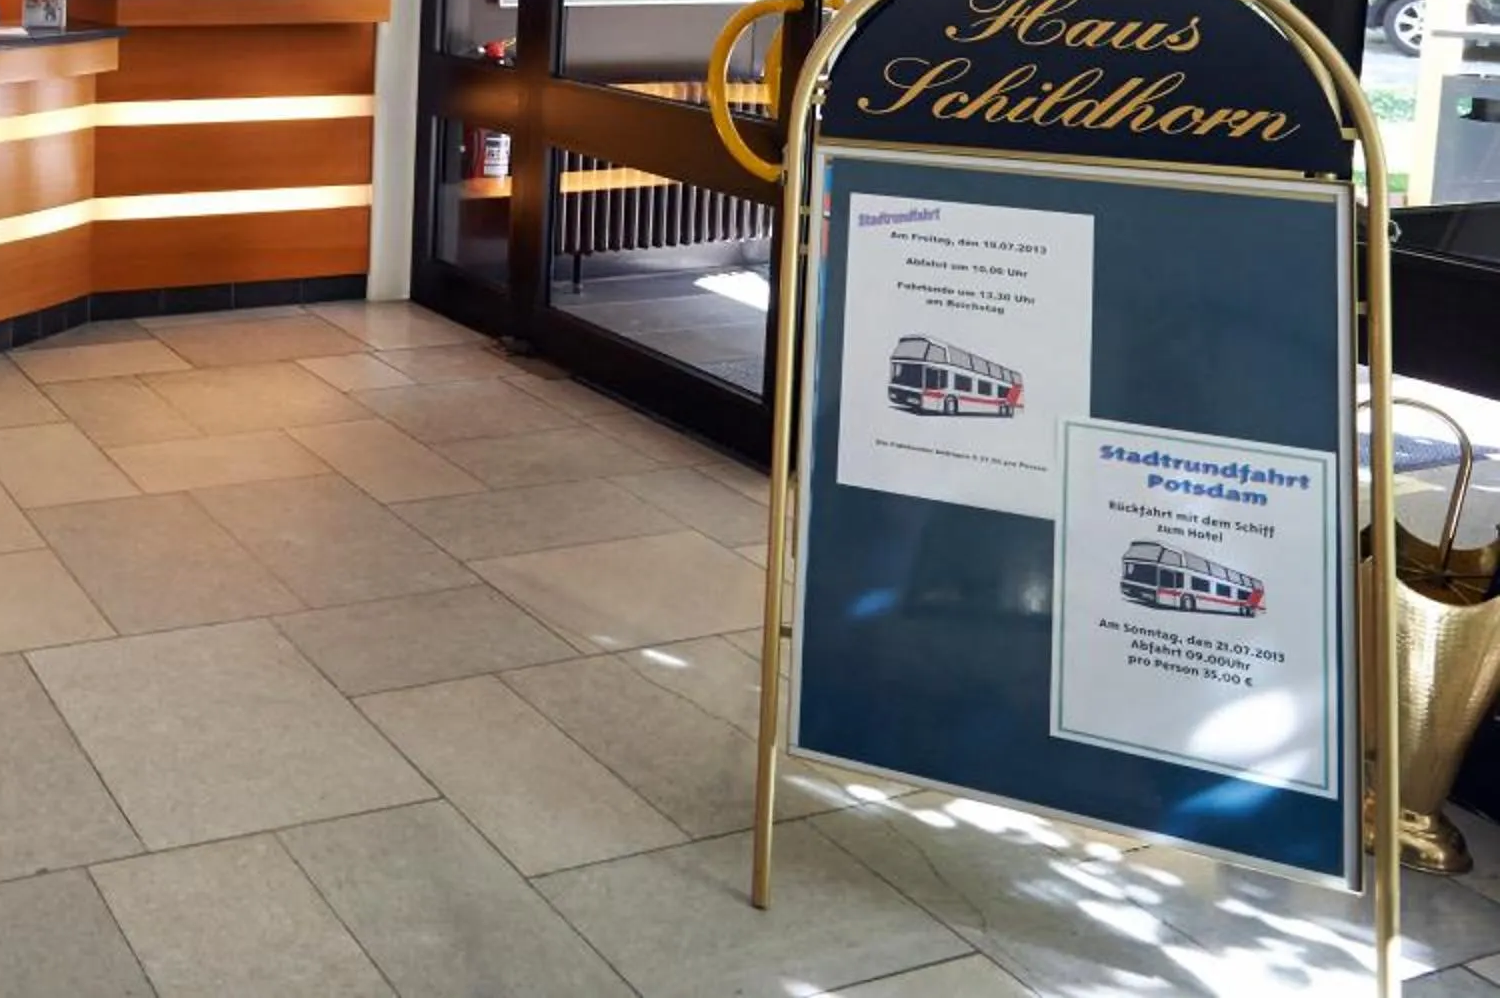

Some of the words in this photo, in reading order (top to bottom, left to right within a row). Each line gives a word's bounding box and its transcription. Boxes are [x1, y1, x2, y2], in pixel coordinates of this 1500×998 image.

[857, 57, 1301, 142] Schildhorn
[858, 208, 941, 226] Stadtrundfahrt
[911, 233, 955, 247] Freitag,
[958, 238, 980, 247] den
[905, 257, 947, 270] Abfahrt
[950, 263, 969, 271] um
[1007, 268, 1029, 278] Uhr
[925, 299, 943, 308] am
[946, 299, 1005, 315] Reichstag
[958, 289, 976, 297] um
[1014, 294, 1036, 305] Uhr
[1099, 445, 1311, 490] Stadtrundfahrt
[1147, 474, 1268, 506] Potsdam
[1108, 500, 1172, 519] Rückfahrt
[1175, 512, 1199, 523] mit
[1201, 515, 1231, 529] dem
[1235, 521, 1276, 539] Schiff
[1156, 524, 1185, 536] zum
[1187, 529, 1224, 543] Hotel
[1098, 618, 1120, 631] Am
[1123, 623, 1183, 645] Sonntag,
[1186, 635, 1213, 649] den
[1215, 640, 1286, 663] 21.07.2013
[1130, 639, 1182, 658] Abfahrt
[1127, 655, 1151, 668] pro
[1154, 659, 1200, 676] Person
